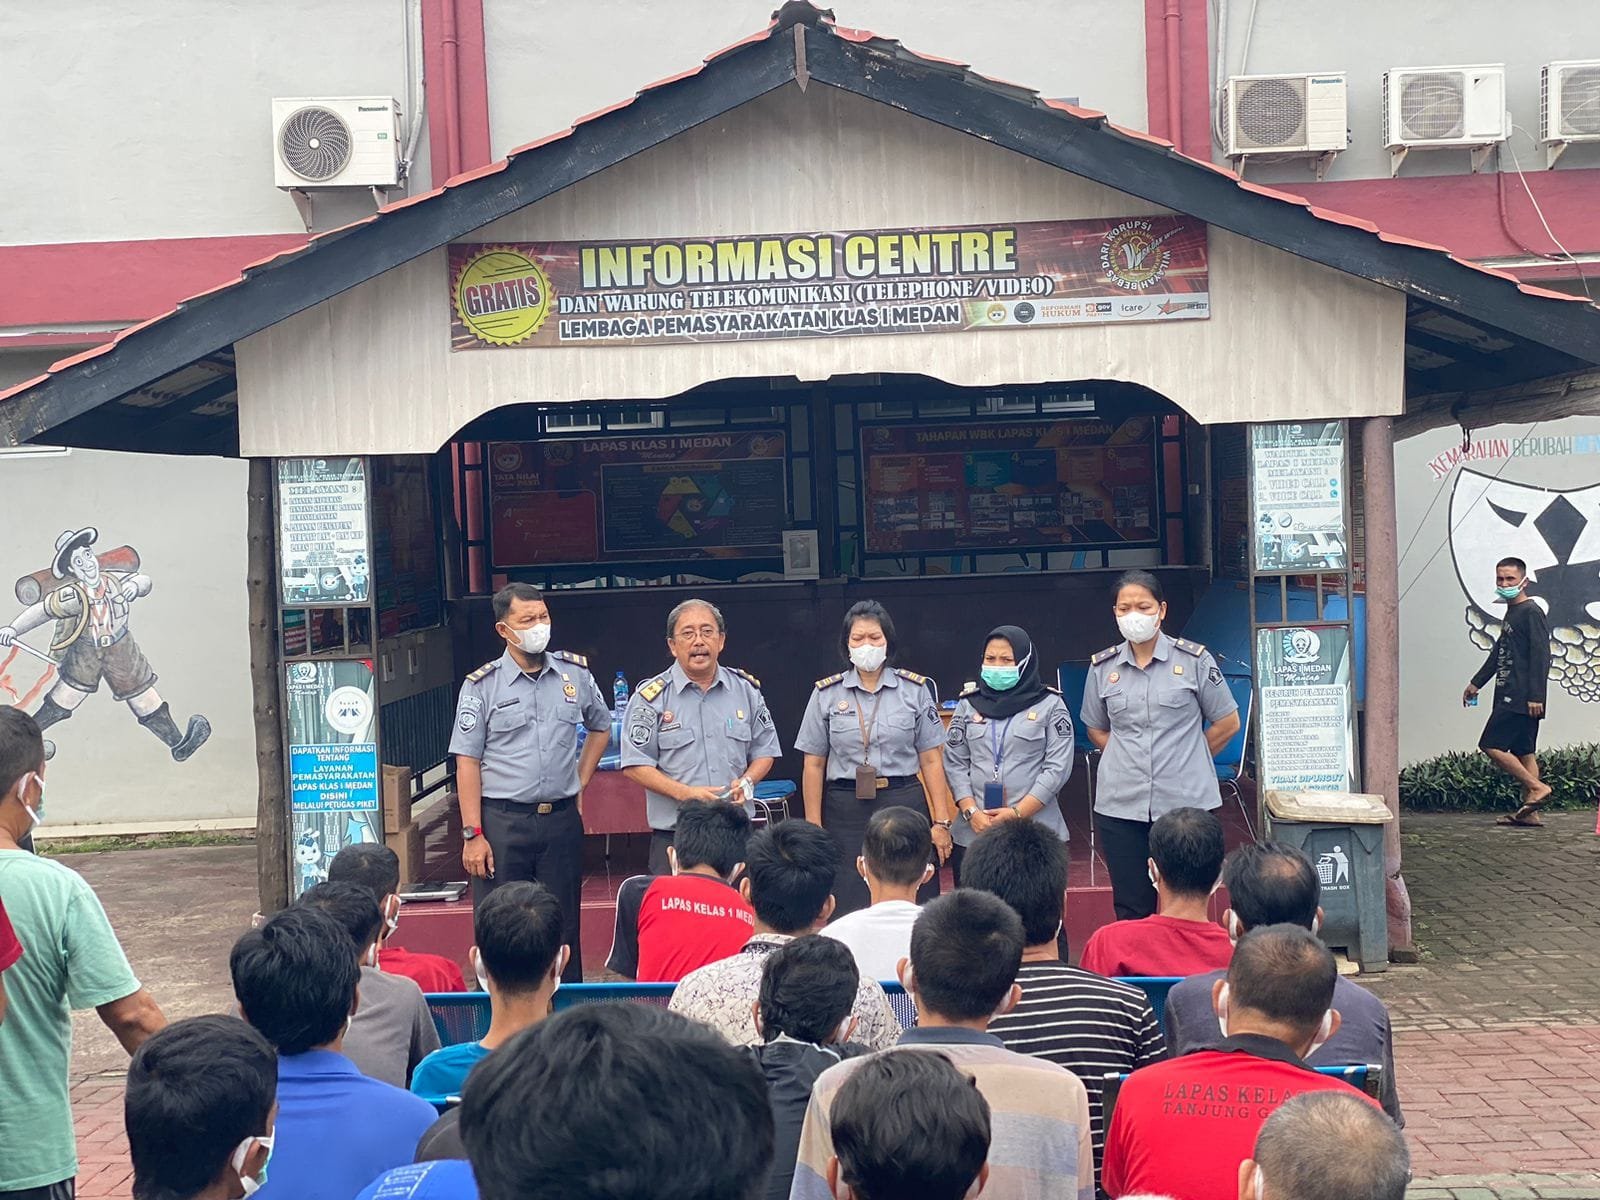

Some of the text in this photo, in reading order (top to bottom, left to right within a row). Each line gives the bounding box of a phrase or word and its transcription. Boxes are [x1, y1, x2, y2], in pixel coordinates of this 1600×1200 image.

[1100, 242, 1110, 269] DARI
[1107, 220, 1152, 241] KORUPSI
[582, 230, 1017, 288] INFORMASI CENTRE
[1141, 250, 1171, 289] WILAYAH
[1106, 270, 1139, 290] BEBAS
[465, 277, 541, 316] GRATIS
[559, 276, 1054, 313] DAN WARUNG TELEKOMUNIKASI (TELEPHONE/VIDEO)
[560, 305, 959, 338] LEMBAGA PEMASYARAKATAN KLAS I MEDAN
[1042, 309, 1081, 318] HUKUM
[916, 430, 966, 442] TAHAPAN
[969, 429, 995, 440] WBK
[998, 427, 1033, 439] LAPAS
[1073, 424, 1113, 435] MEDAN
[583, 436, 732, 452] LAPAS KLAS I MEDAN
[1512, 437, 1572, 457] BERUBAH
[1273, 665, 1297, 674] LAPAS
[1303, 664, 1331, 673] MEDAN
[292, 745, 374, 755] DAPATKAN INFORMASI
[317, 754, 350, 762] TENTANG
[293, 772, 375, 780] PEMASYARAKATAN
[313, 764, 353, 773] LAYANAN
[293, 783, 317, 791] LAPAS
[319, 782, 339, 790] KLAS
[345, 781, 373, 790] MEDAN
[320, 792, 348, 800] DISINI
[325, 800, 355, 809] PETUGAS
[357, 800, 375, 808] PIKET
[661, 897, 692, 912] LAPAS
[693, 902, 725, 917] KELAS
[727, 907, 733, 917] 1
[1164, 1082, 1305, 1104] LAPAS KELA
[1163, 1102, 1249, 1119] TANJUNG
